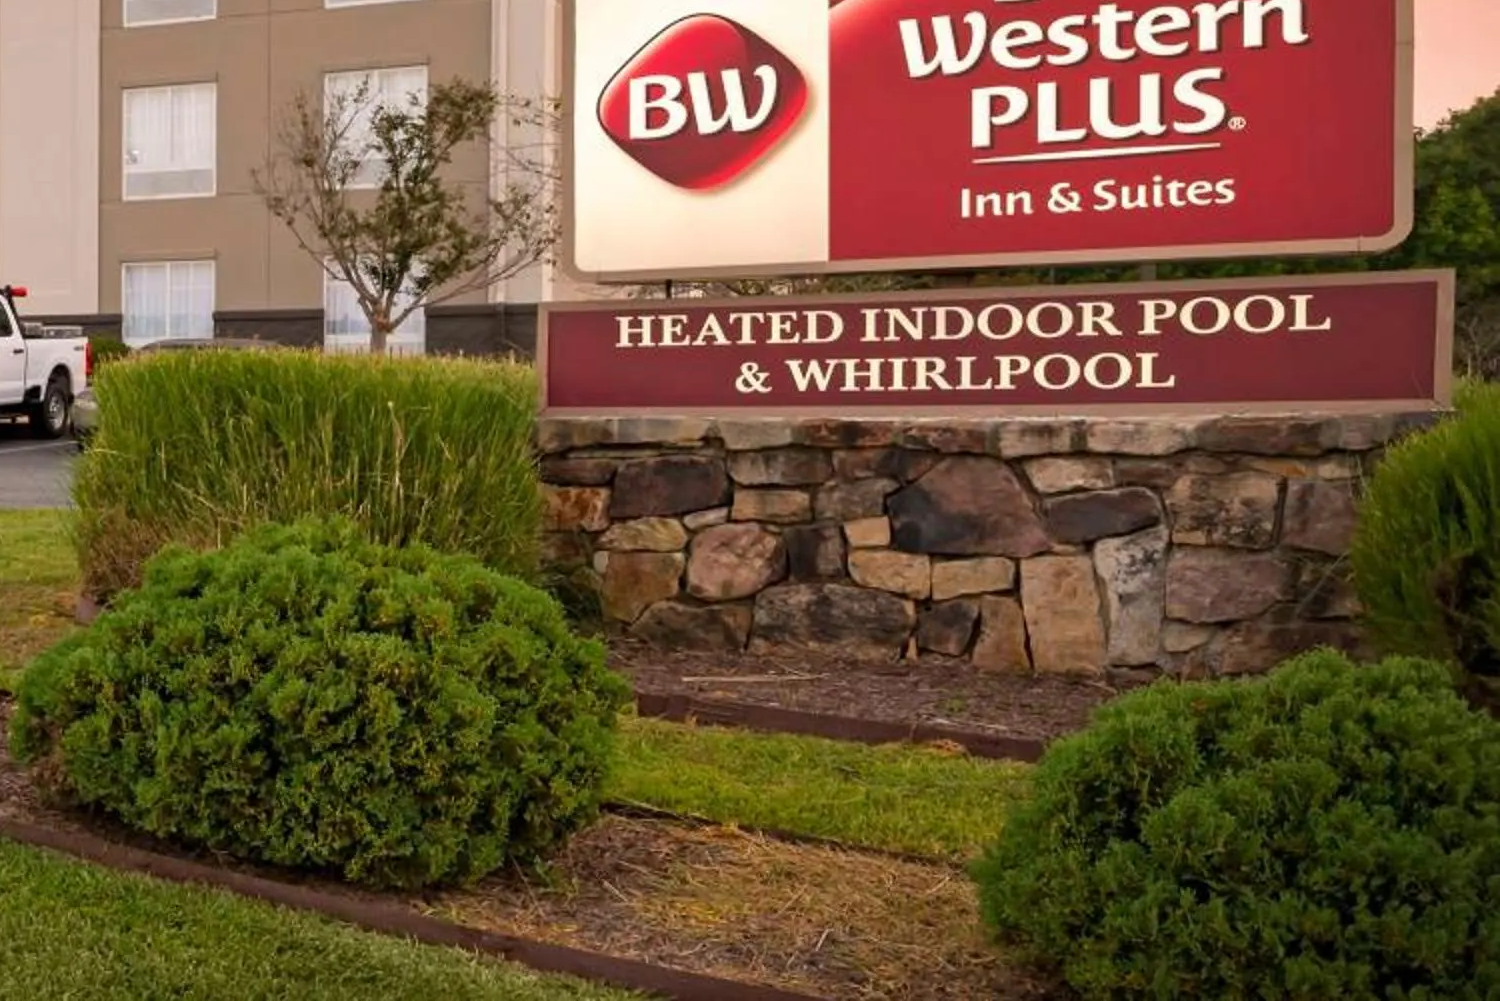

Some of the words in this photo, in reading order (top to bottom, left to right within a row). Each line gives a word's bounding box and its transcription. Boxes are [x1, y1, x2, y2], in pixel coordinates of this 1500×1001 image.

[627, 63, 778, 141] BW
[960, 187, 1034, 218] Inn
[1047, 181, 1083, 215] &
[1092, 174, 1236, 212] Suites
[614, 310, 845, 349] HEATED
[860, 301, 1124, 342] INDOOR
[1136, 293, 1332, 336] POOL
[734, 360, 773, 394] &
[784, 351, 1176, 393] WHIRLPOOL
